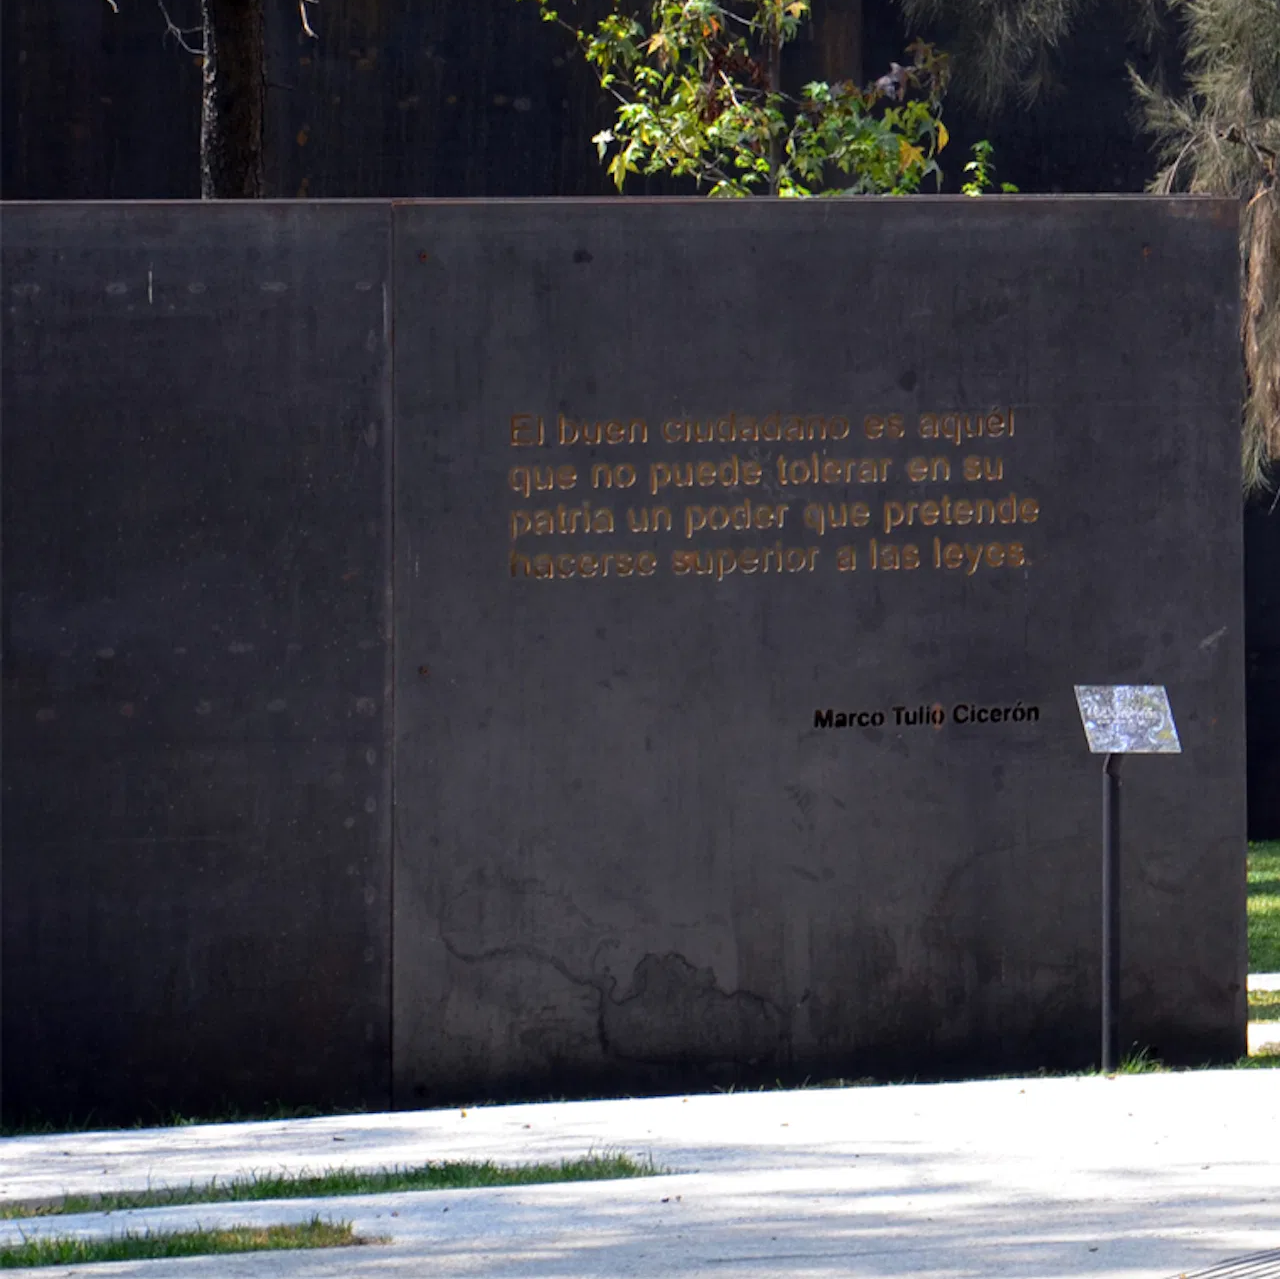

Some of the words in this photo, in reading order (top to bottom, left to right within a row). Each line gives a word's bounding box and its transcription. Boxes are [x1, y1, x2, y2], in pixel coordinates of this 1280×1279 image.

[510, 413, 544, 446] El
[558, 413, 648, 445] buen
[662, 410, 850, 443] ciudadano
[864, 412, 906, 440] es
[918, 405, 1016, 446] aquél
[508, 465, 578, 498] que
[591, 462, 637, 489] no
[650, 454, 762, 495] puede
[776, 450, 893, 485] tolerar
[906, 455, 951, 483] en
[963, 454, 1004, 482] su
[510, 500, 615, 540] patria
[627, 504, 673, 533] un
[685, 497, 789, 539] poder
[804, 500, 870, 535] que
[883, 492, 1040, 534] pretende
[510, 548, 658, 580] hacerse
[671, 539, 820, 582] superior
[836, 544, 857, 571] a
[869, 537, 920, 570] las
[933, 536, 1032, 576] leyes.
[813, 709, 885, 728] Marco
[892, 705, 945, 726] Tulio
[953, 701, 1040, 725] Cicerón
